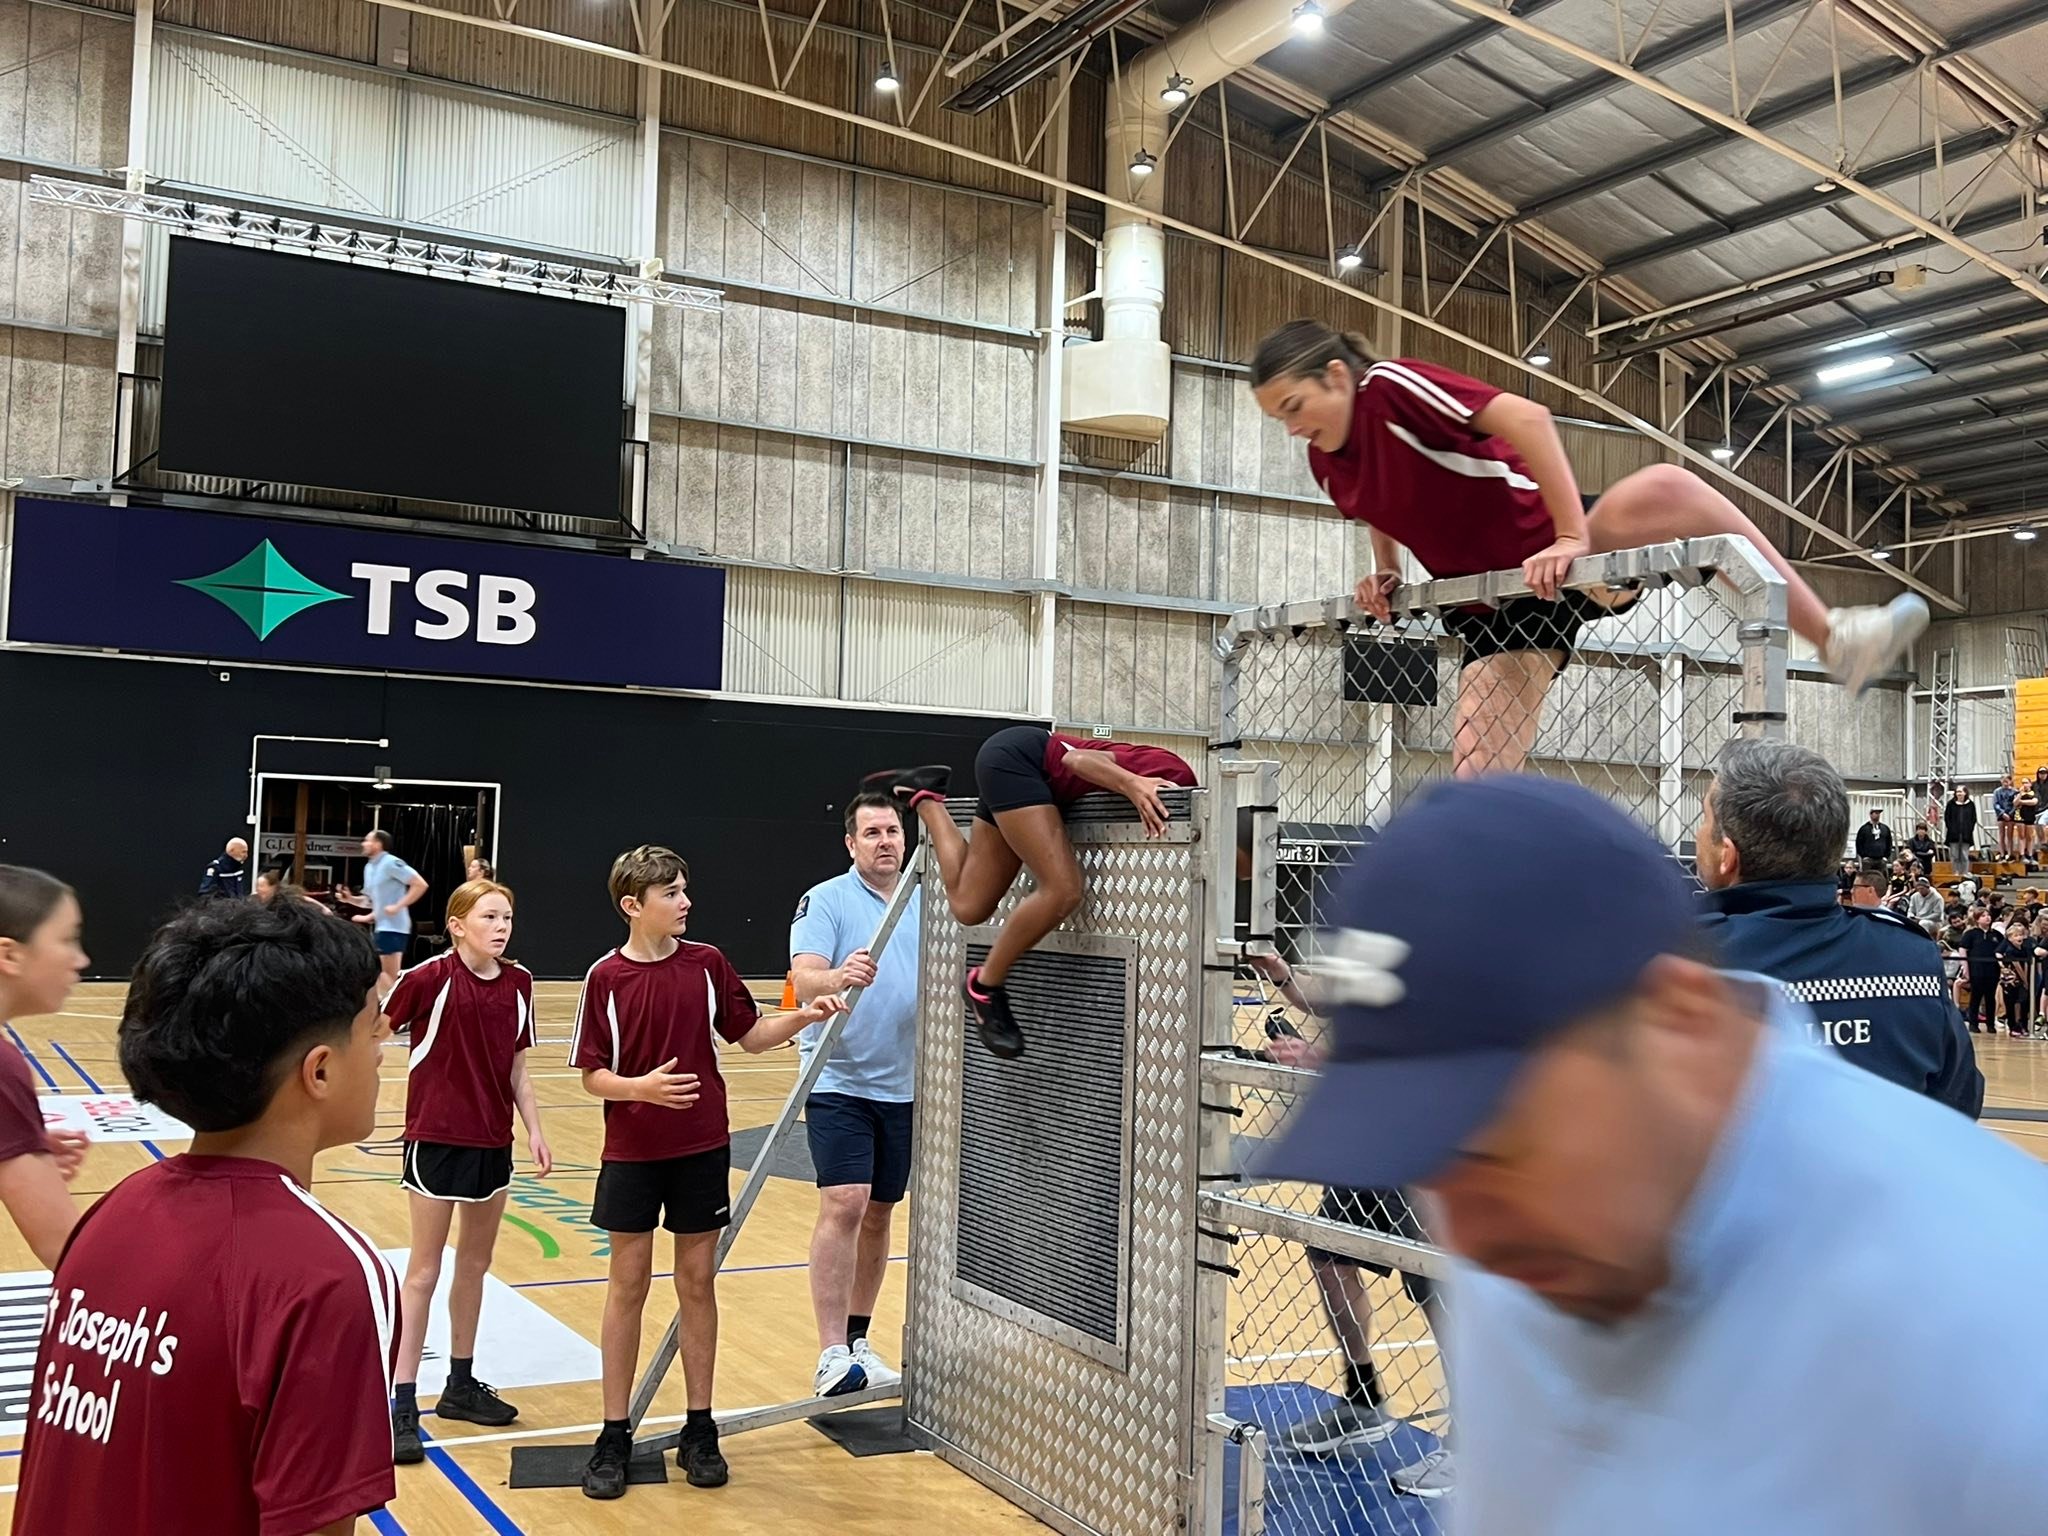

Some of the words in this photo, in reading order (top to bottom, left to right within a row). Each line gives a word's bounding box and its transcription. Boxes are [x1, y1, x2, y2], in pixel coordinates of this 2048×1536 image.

[351, 562, 537, 646] TSB
[265, 838, 285, 852] G.J.
[287, 839, 333, 852] Gdner.
[1275, 845, 1302, 861] ourt
[1304, 846, 1313, 861] 3
[1804, 1018, 1872, 1047] LICE
[58, 1287, 179, 1377] Joseph's
